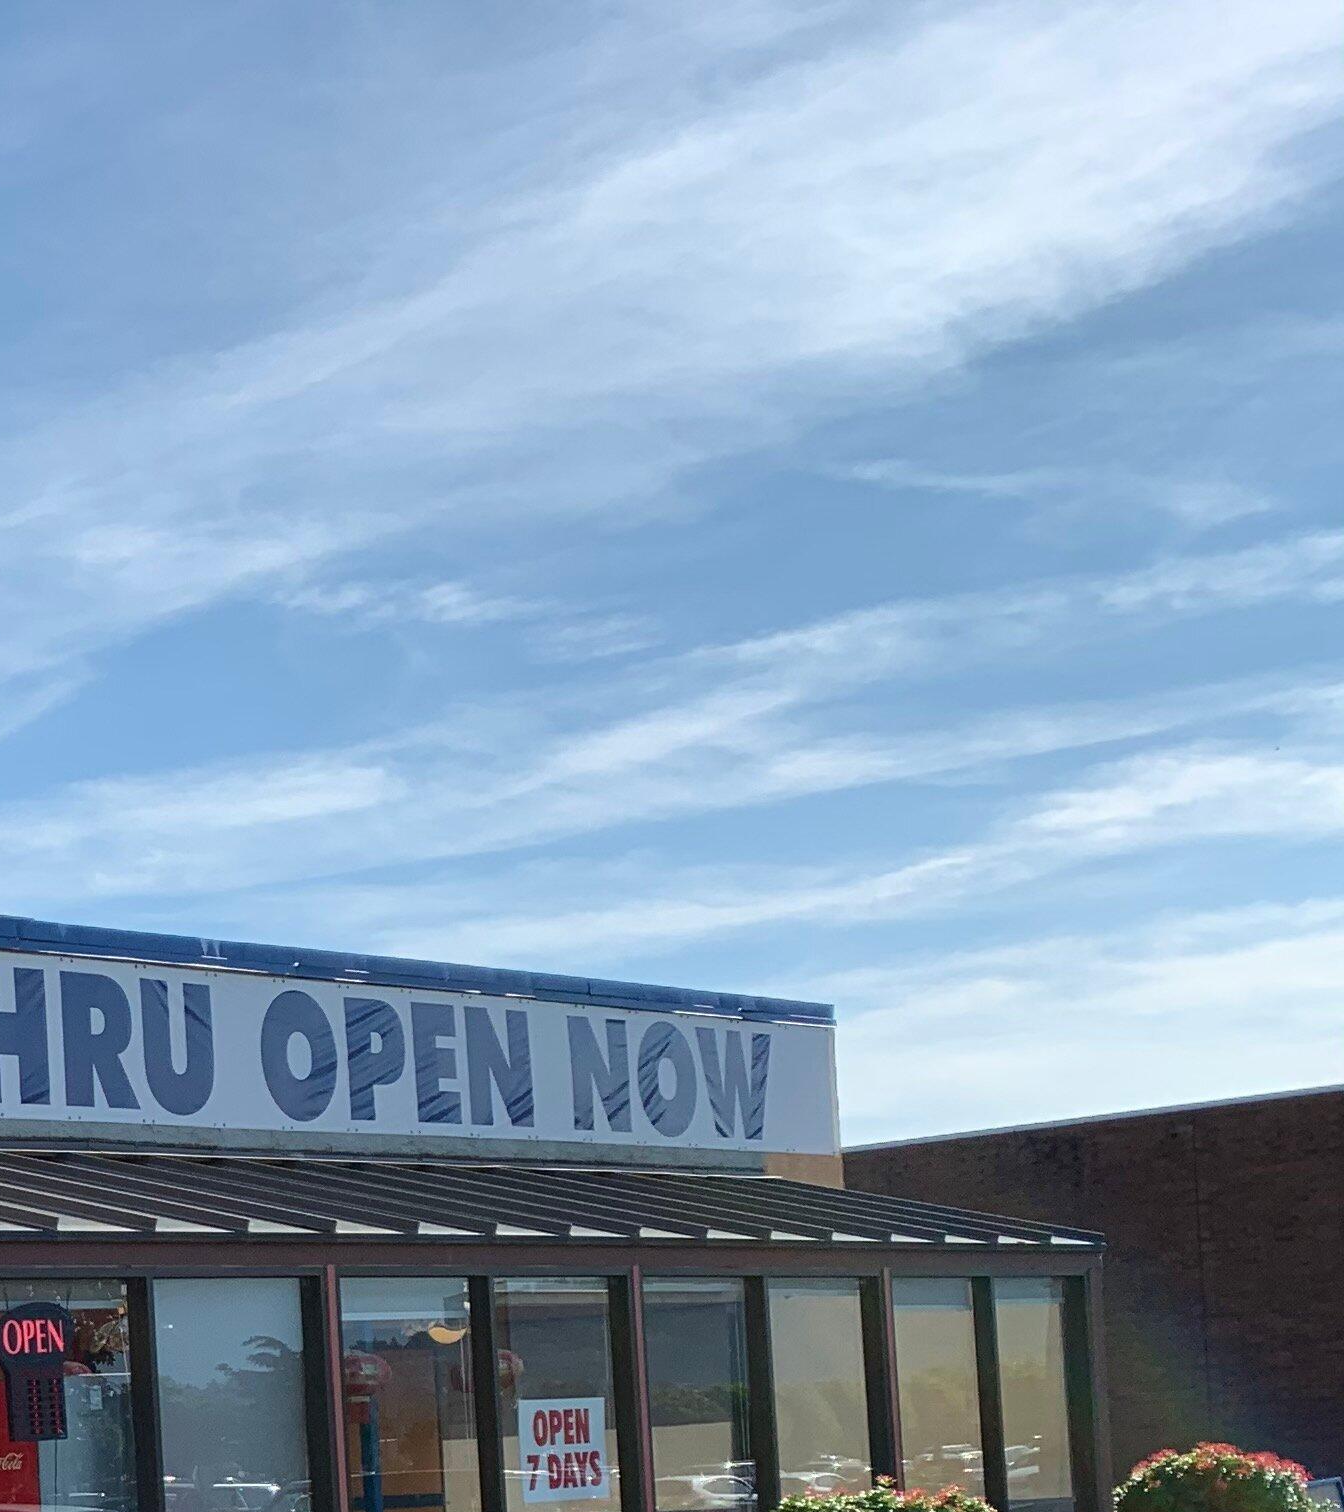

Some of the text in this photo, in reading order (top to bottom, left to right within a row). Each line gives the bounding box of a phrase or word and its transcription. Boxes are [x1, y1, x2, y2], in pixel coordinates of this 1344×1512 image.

[260, 990, 535, 1127] OPEN
[567, 1015, 771, 1141] NOW
[2, 1318, 65, 1356] OPEN
[533, 1408, 591, 1447] OPEN
[527, 1451, 602, 1491] 7 DAYS
